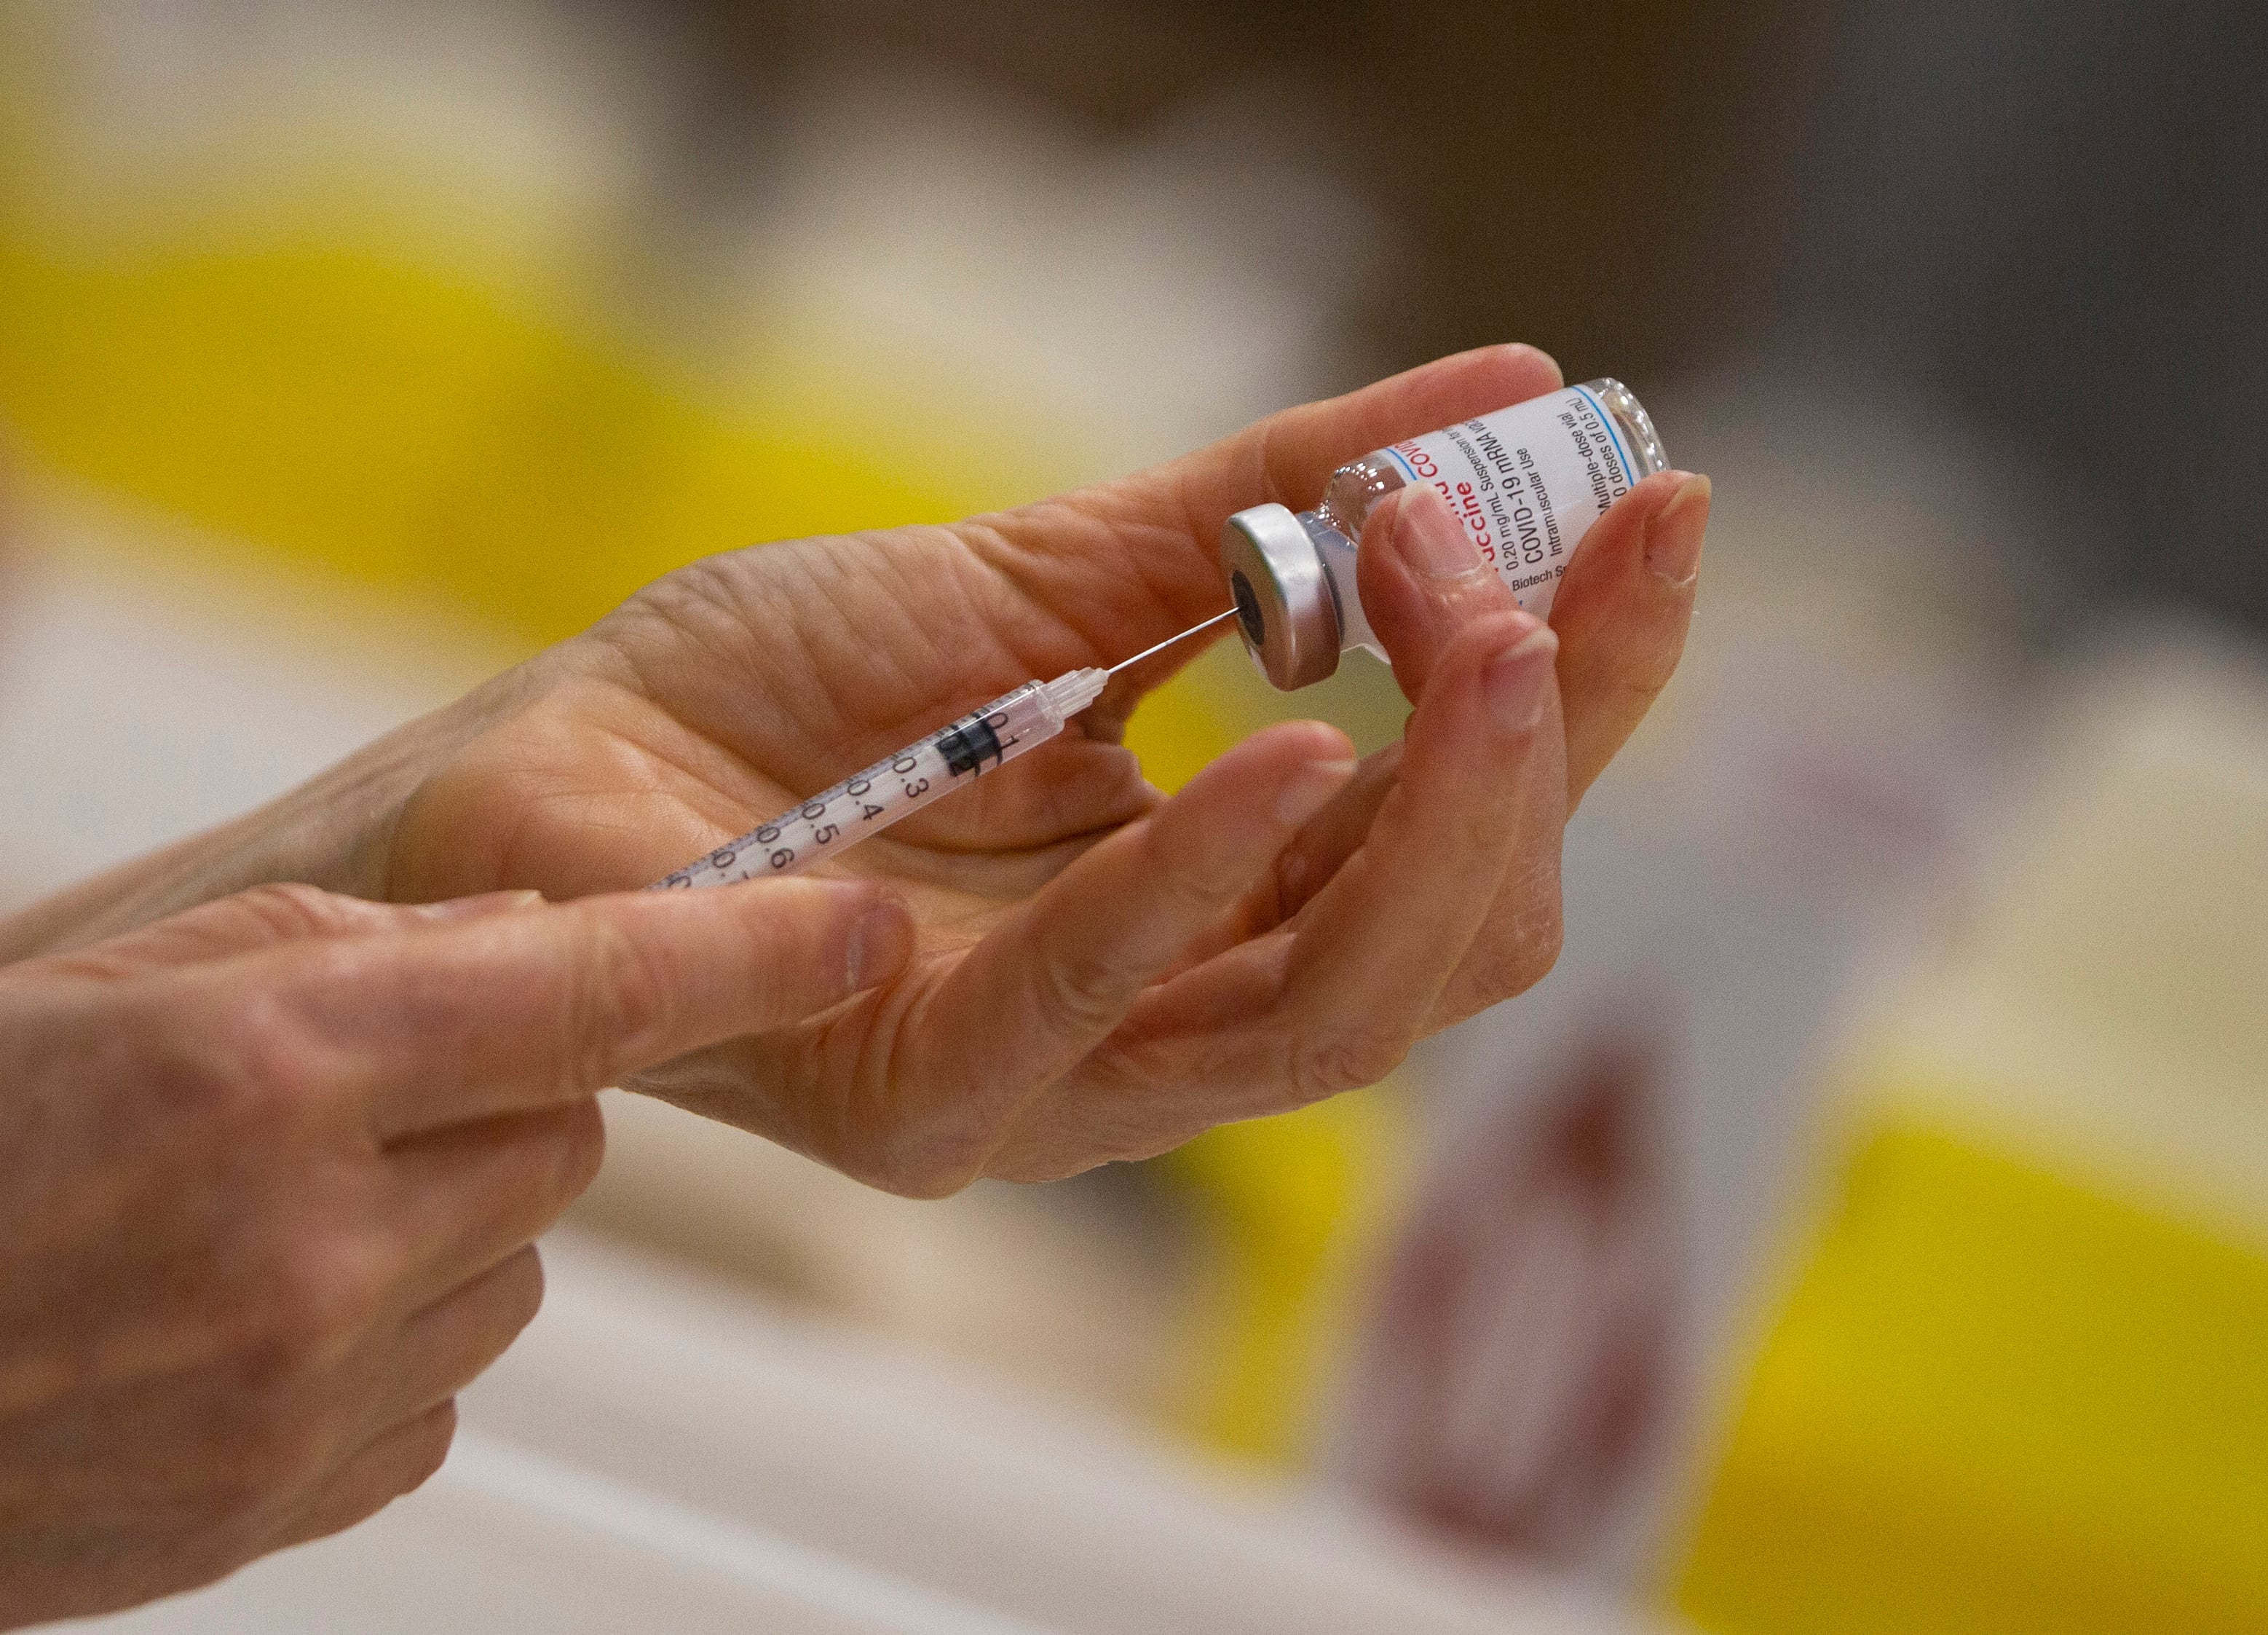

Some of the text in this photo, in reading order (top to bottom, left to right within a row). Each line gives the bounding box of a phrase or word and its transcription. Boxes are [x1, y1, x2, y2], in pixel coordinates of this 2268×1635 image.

[1557, 411, 1577, 429] vial
[1579, 412, 1600, 430] 0.5
[1590, 431, 1607, 443] of
[1456, 438, 1495, 492] Suspension
[1476, 432, 1514, 473] mRNA
[1600, 445, 1624, 484] doses
[1486, 492, 1512, 538] mg/mL
[1501, 476, 1544, 564] COVID-19
[1517, 447, 1563, 557] Intramuscular Use
[1456, 481, 1498, 570] accine
[1501, 540, 1520, 571] 0.20
[1512, 570, 1552, 591] Biotech
[987, 712, 1019, 750] 01
[893, 757, 928, 797] 0.3
[847, 779, 884, 821] 0.4
[802, 803, 839, 844] 0.5
[757, 827, 794, 869] 0.6
